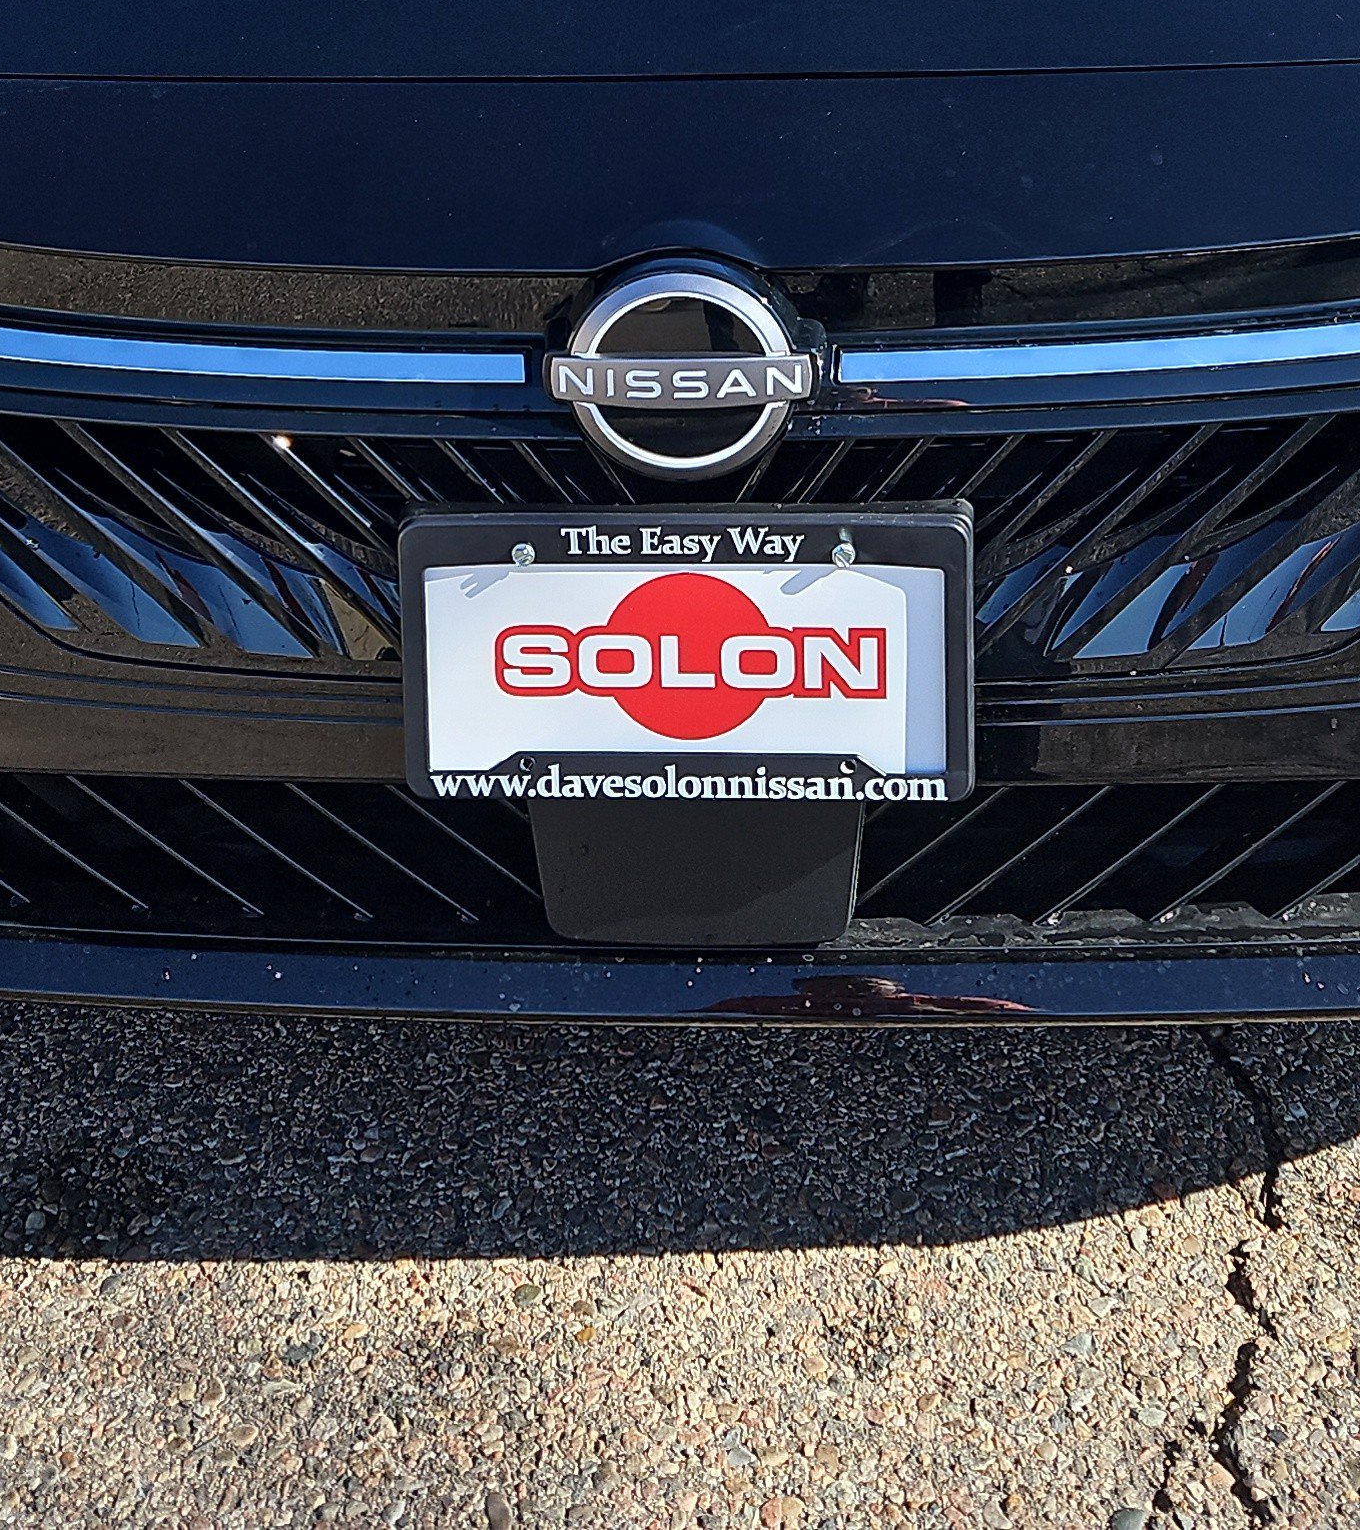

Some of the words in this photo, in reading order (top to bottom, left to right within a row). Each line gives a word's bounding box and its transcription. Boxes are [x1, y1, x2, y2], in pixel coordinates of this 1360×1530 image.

[557, 363, 804, 401] NISSAN
[560, 525, 631, 556] The
[639, 526, 722, 563] Easy
[726, 526, 805, 563] Way
[499, 630, 882, 693] SOLON
[430, 763, 948, 802] www.davesolonnissan.com
